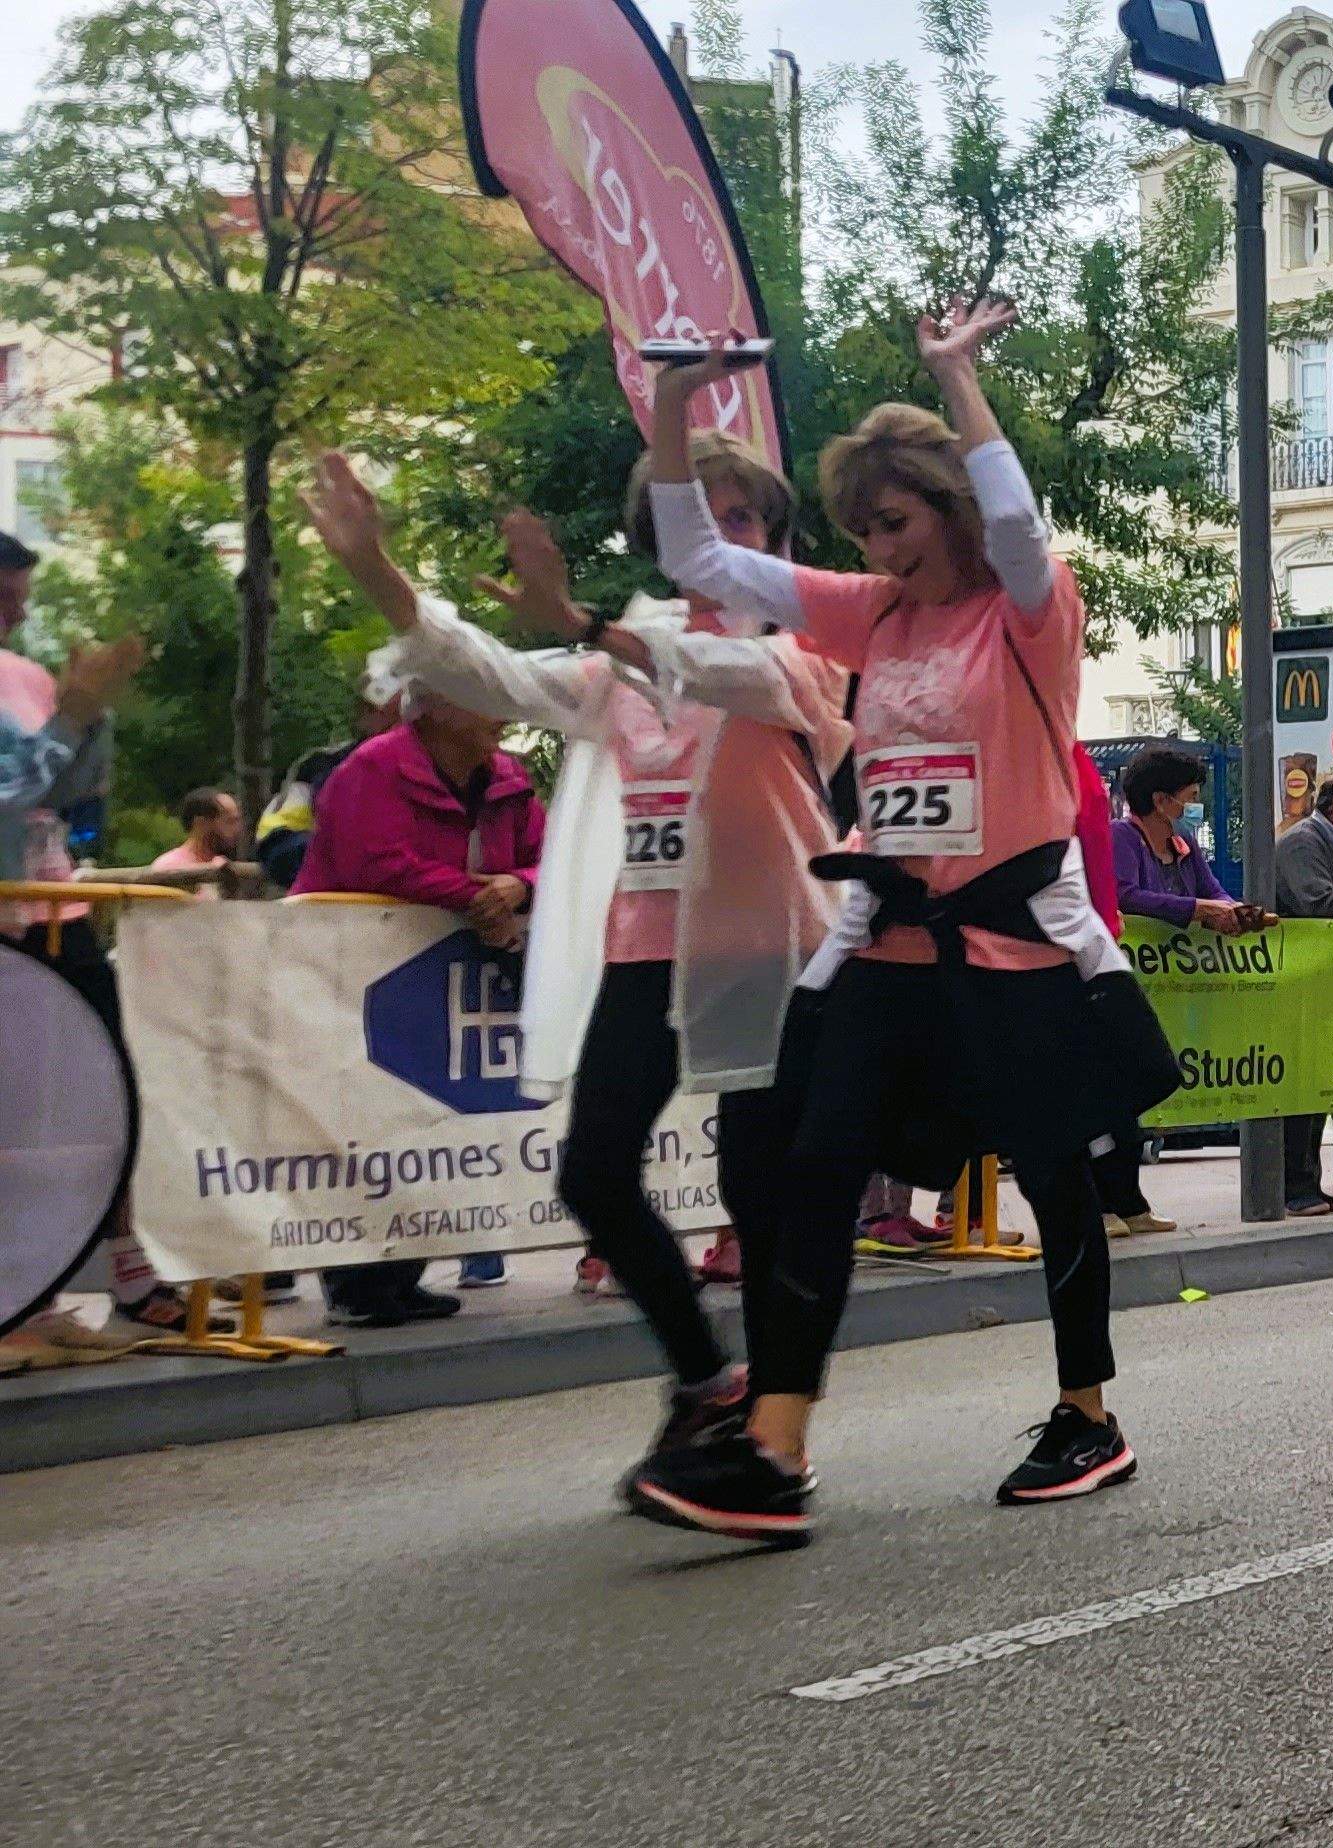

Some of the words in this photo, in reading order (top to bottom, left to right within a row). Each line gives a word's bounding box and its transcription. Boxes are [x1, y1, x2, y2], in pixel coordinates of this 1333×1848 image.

[869, 785, 951, 829] 225
[196, 1141, 503, 1199] Hormigones
[271, 1215, 368, 1248] ÁRIDOS
[386, 1202, 508, 1240] ASFALTOS
